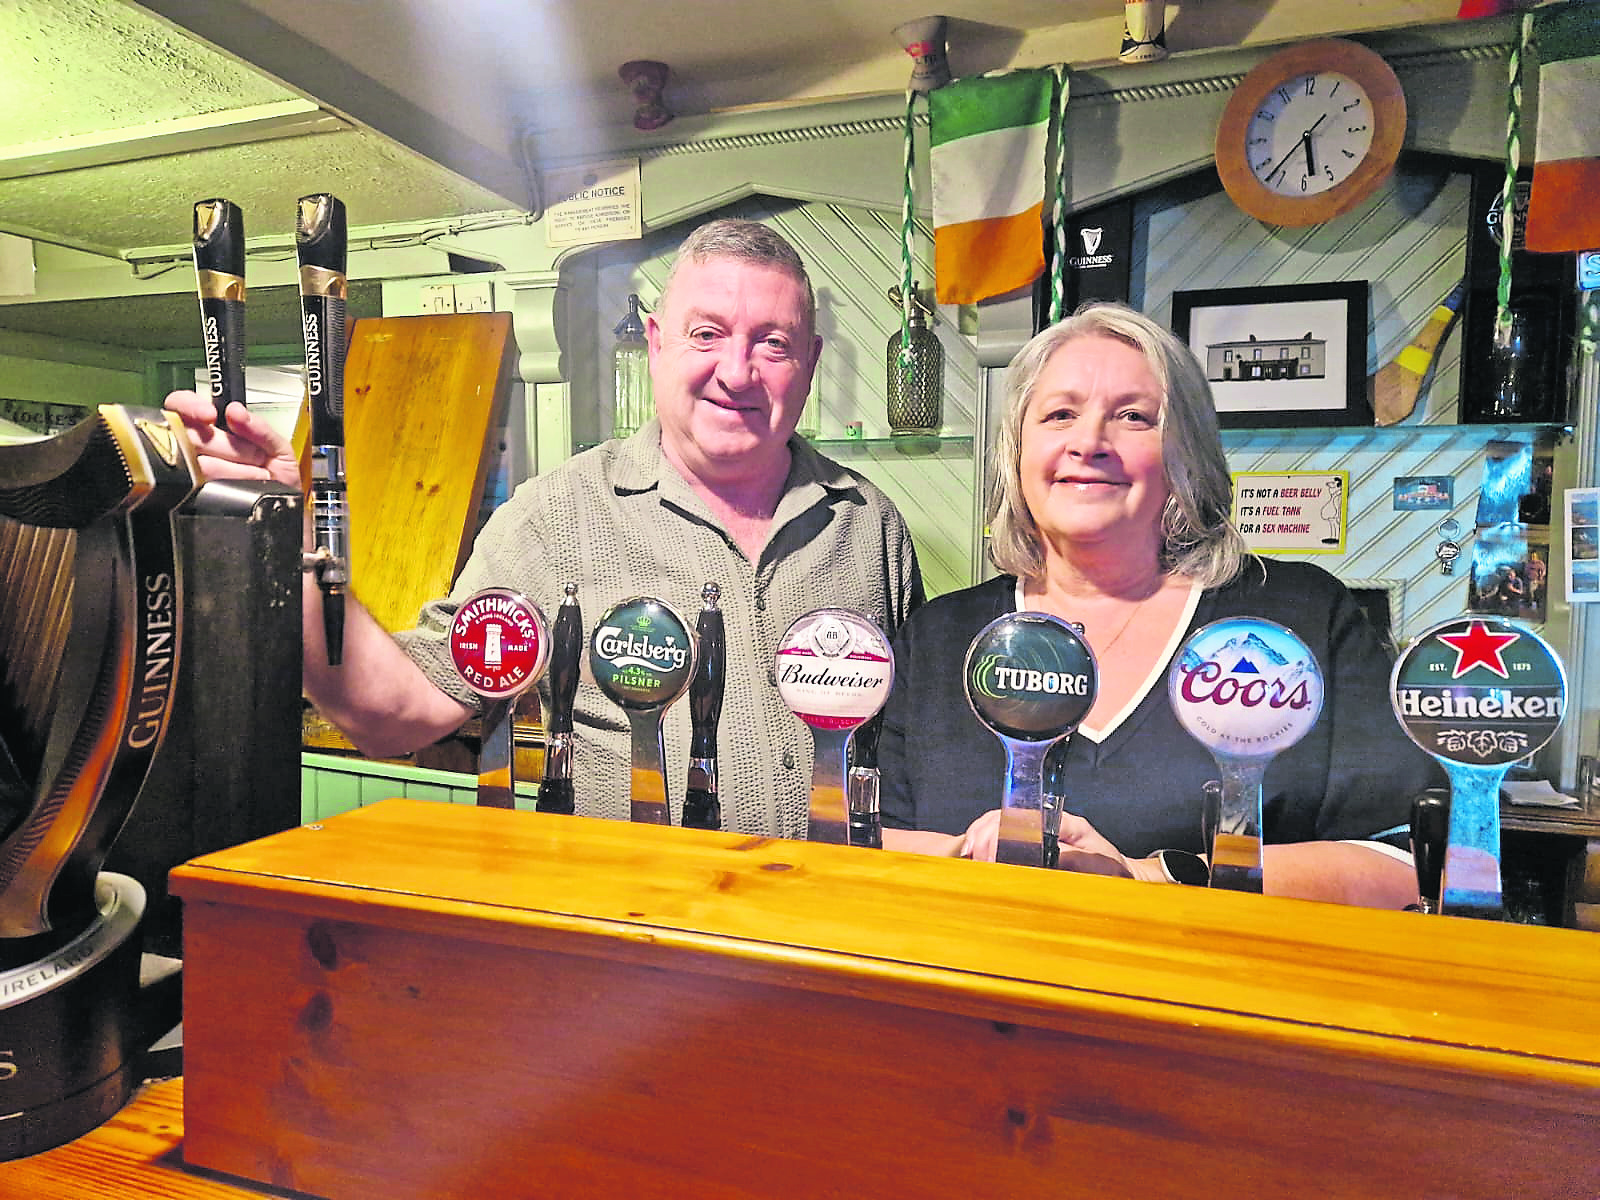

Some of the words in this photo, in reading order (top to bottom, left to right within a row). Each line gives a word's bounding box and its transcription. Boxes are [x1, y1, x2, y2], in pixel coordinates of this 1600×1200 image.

[1305, 76, 1316, 96] 12
[1329, 81, 1341, 98] 1
[1278, 87, 1292, 104] 11
[1343, 98, 1361, 112] 2
[1324, 165, 1335, 181] 5
[591, 186, 625, 198] NOTICE
[1301, 173, 1308, 193] 6
[1069, 254, 1113, 266] GUINNESS
[207, 316, 224, 397] GUINNESS
[306, 313, 322, 396] GUINNESS
[1241, 488, 1255, 498] IT'S
[1256, 488, 1272, 498] NOT
[1273, 488, 1279, 498] A
[1280, 488, 1299, 498] BEER
[1300, 488, 1322, 498] BELLY
[1240, 506, 1254, 516] IT'S
[1255, 506, 1261, 516] A
[1262, 506, 1280, 516] FUEL
[1282, 506, 1302, 516] TANK
[1239, 523, 1254, 533] FOR
[1255, 523, 1261, 533] A
[1262, 523, 1276, 533] SEX
[1277, 523, 1311, 533] MACHINE
[459, 642, 479, 650] IRISH
[507, 644, 529, 652] MADE
[596, 626, 686, 670] Carlsberg
[128, 572, 175, 749] GUINNESS
[1429, 663, 1448, 671] EST.
[464, 664, 494, 688] RED
[499, 665, 525, 688] ALE
[612, 673, 661, 688] PILSNER
[780, 663, 883, 688] Budweiser
[994, 666, 1088, 696] TUBORG
[1180, 661, 1312, 711] Coors
[1397, 689, 1562, 718] Heineken
[1196, 715, 1218, 734] COLD
